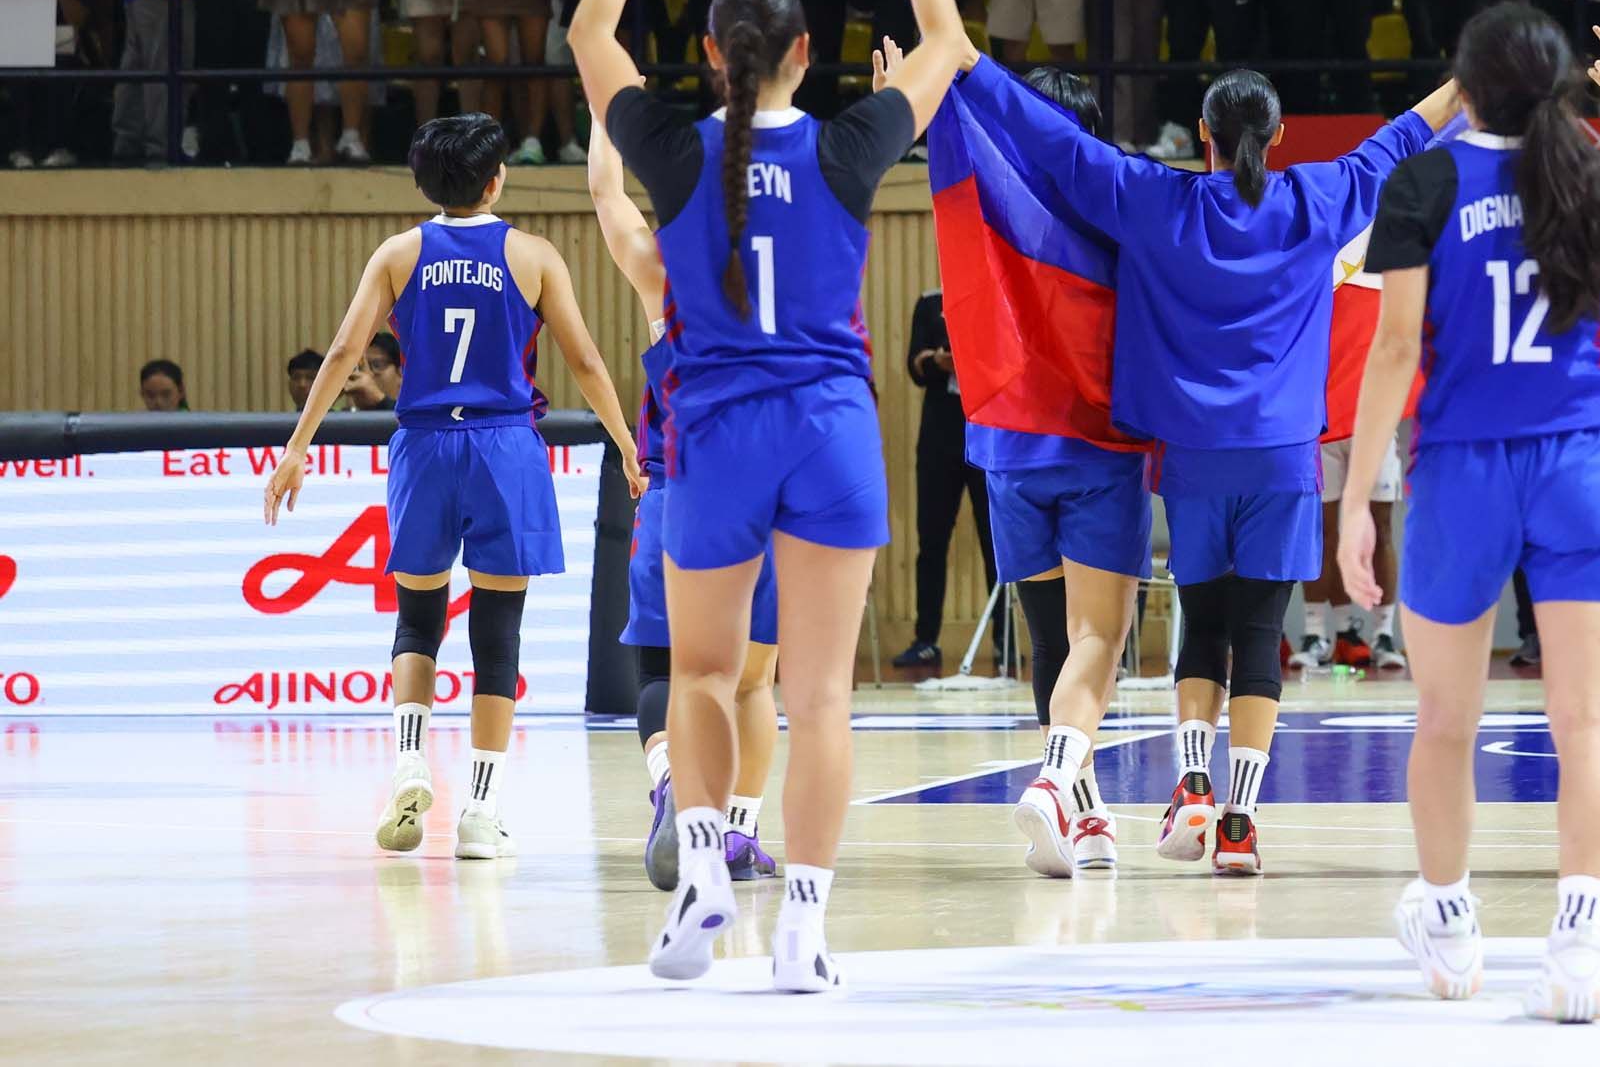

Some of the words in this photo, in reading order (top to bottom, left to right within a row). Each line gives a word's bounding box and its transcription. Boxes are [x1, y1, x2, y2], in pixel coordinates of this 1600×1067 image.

[746, 162, 792, 204] EYN
[1459, 194, 1525, 242] DIGNA
[421, 259, 504, 292] PONTEJOS
[751, 236, 777, 335] 1
[1485, 259, 1553, 365] 12
[444, 307, 476, 384] 7
[162, 448, 231, 476] Eat
[213, 671, 528, 710] AJINOO
